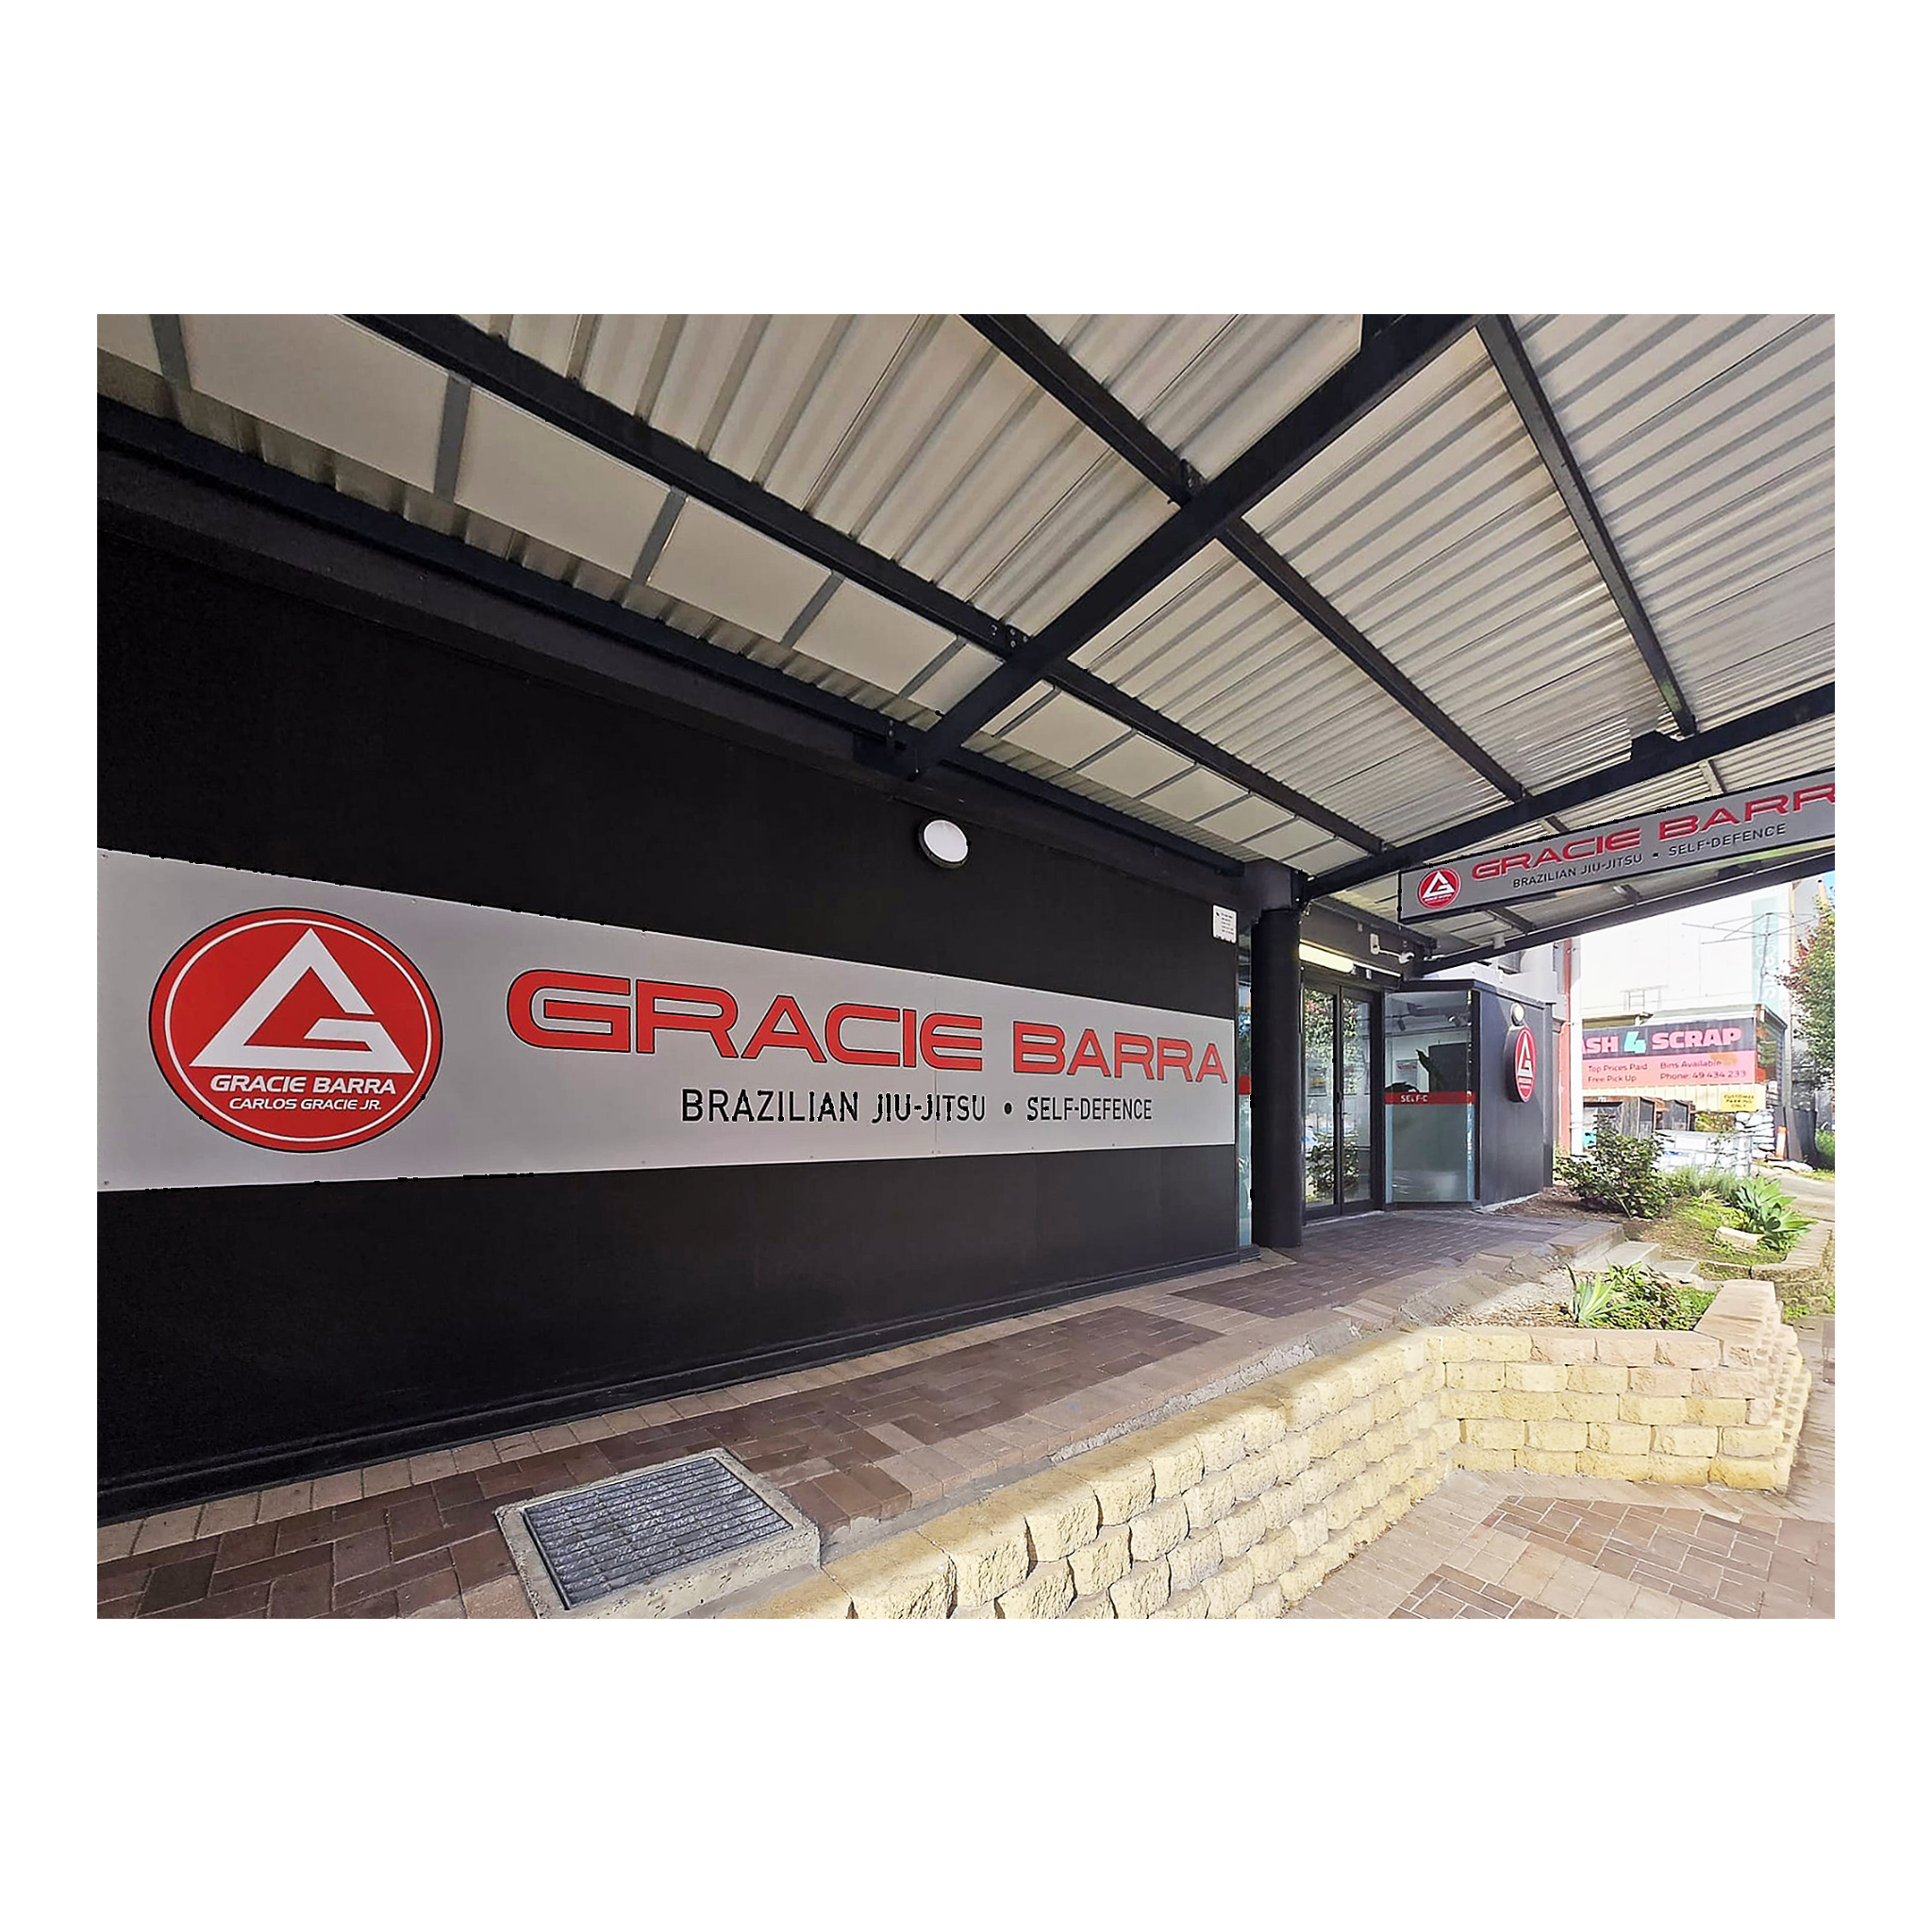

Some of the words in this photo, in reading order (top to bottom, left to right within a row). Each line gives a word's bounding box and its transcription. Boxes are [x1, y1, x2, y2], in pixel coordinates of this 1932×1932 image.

[1471, 826, 1642, 880] GRACIE
[1511, 866, 1577, 889] BRAZILIAN
[1580, 853, 1643, 876] JIU-JITSU
[1668, 823, 1787, 856] SELF-DEFENCE
[507, 968, 984, 1071] GRACIE
[1012, 1020, 1228, 1083] BARRA
[1624, 1030, 1647, 1055] 4
[1651, 1027, 1742, 1050] SCRAP
[1588, 1065, 1601, 1074] Top
[1629, 1062, 1648, 1071] Paid
[1660, 1061, 1679, 1070] Bins
[1680, 1059, 1723, 1069] Available
[1727, 1070, 1747, 1078] 233
[209, 1074, 308, 1093] GRACIE
[312, 1076, 397, 1094] BARRA
[1606, 1074, 1624, 1083] Pick
[1624, 1074, 1637, 1083] Up
[229, 1097, 298, 1110] CARLOS
[300, 1098, 358, 1110] GRACIE
[359, 1099, 382, 1111] JR.
[681, 1088, 859, 1124] BRAZILIAN
[871, 1091, 987, 1124] JIU-JITSU
[1025, 1095, 1153, 1123] SELF-DEFENCE
